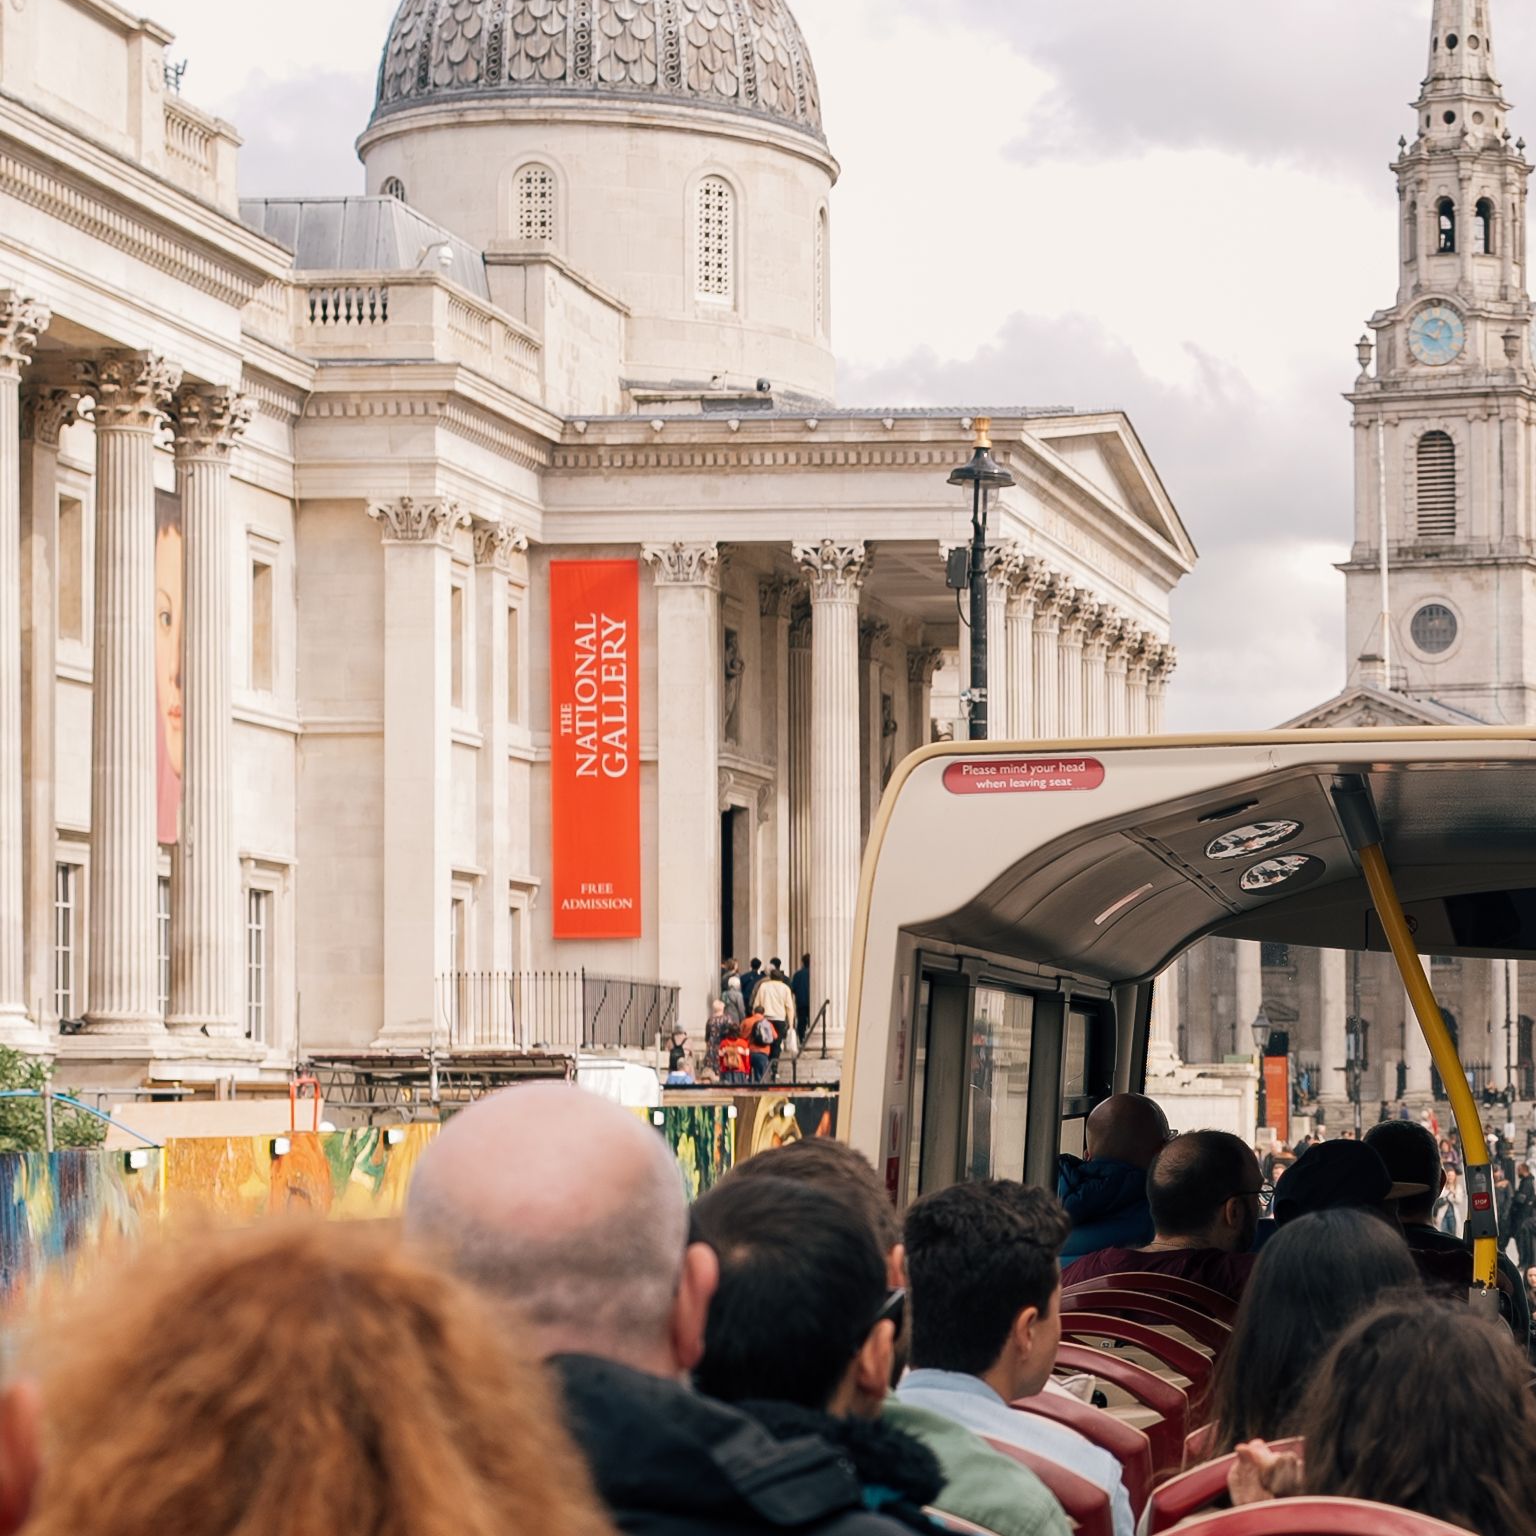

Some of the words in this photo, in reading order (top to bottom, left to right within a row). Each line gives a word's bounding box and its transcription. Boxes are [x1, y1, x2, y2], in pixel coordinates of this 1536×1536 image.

[575, 613, 597, 778] NATIONAL
[601, 613, 628, 778] GALLERY
[560, 703, 572, 736] THE
[962, 764, 997, 775] Please
[1000, 762, 1027, 774] mind
[1030, 764, 1056, 775] your
[1059, 761, 1086, 772] head
[975, 778, 1006, 789] when
[1009, 777, 1046, 790] leaving
[1049, 777, 1072, 787] seat
[581, 882, 613, 895] FREE
[561, 897, 632, 910] ADMISSION
